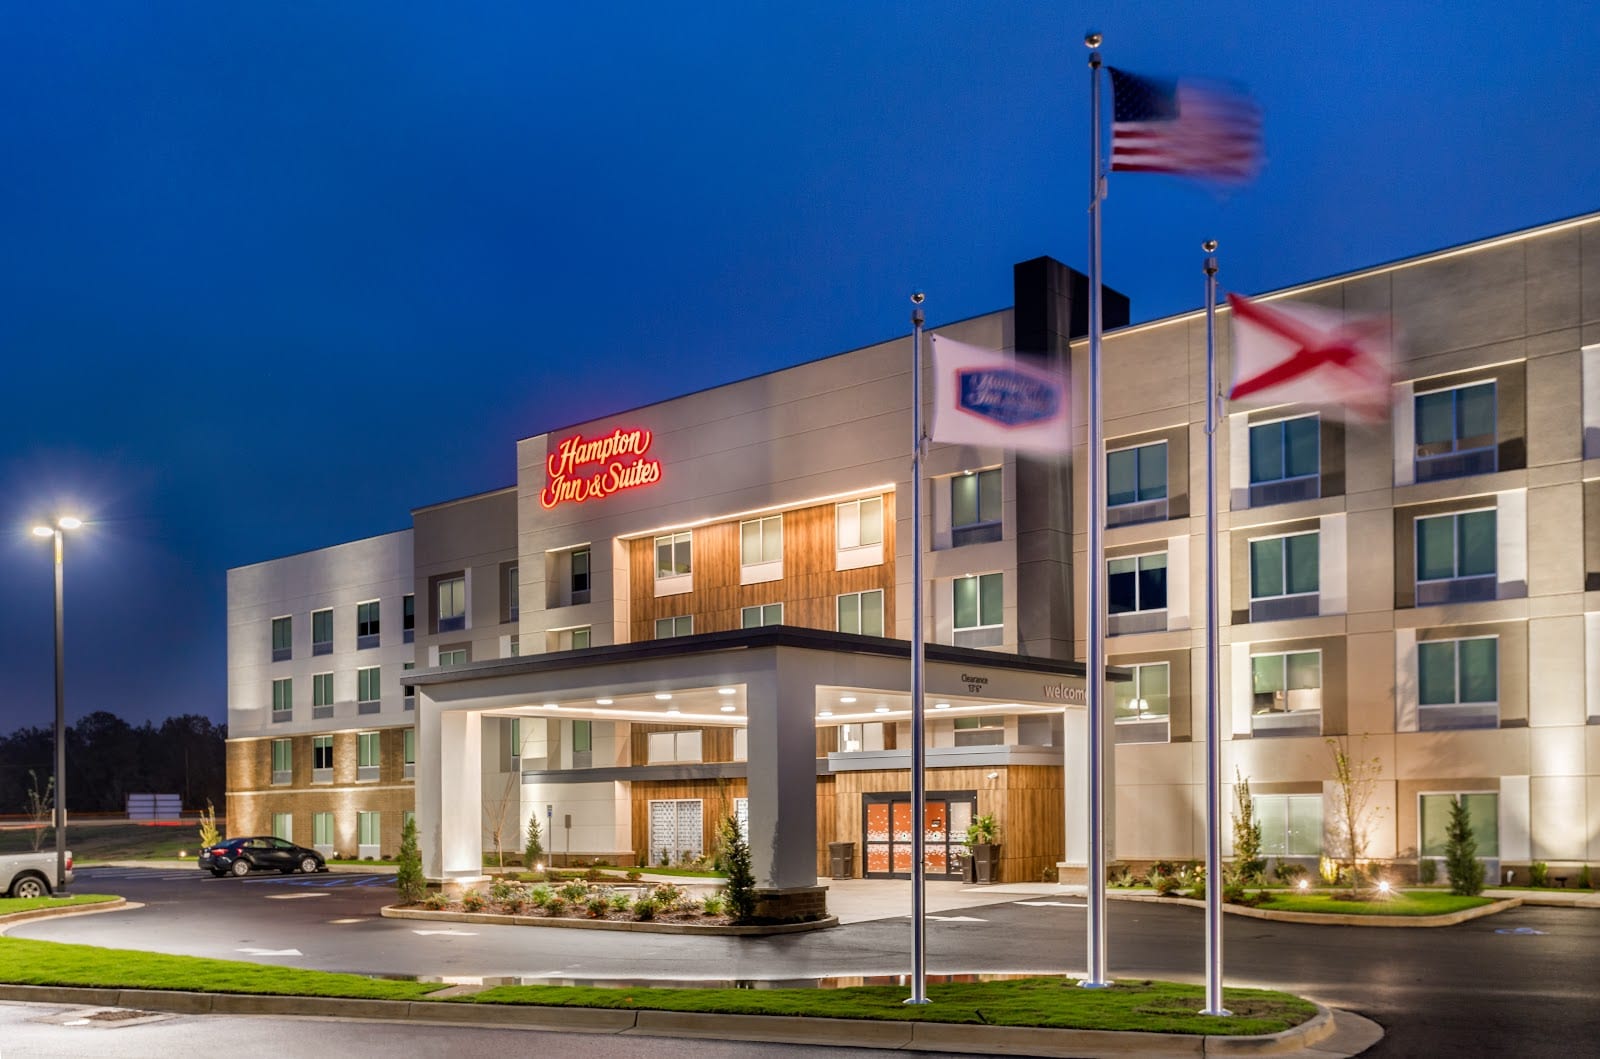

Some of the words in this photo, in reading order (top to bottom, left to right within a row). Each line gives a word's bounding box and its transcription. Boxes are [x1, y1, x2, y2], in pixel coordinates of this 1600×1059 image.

[548, 429, 651, 478] Hampton
[541, 474, 590, 508] Inn
[589, 474, 605, 498] &
[601, 458, 660, 493] Suites
[961, 674, 988, 684] Clearance
[1043, 683, 1087, 700] welcom
